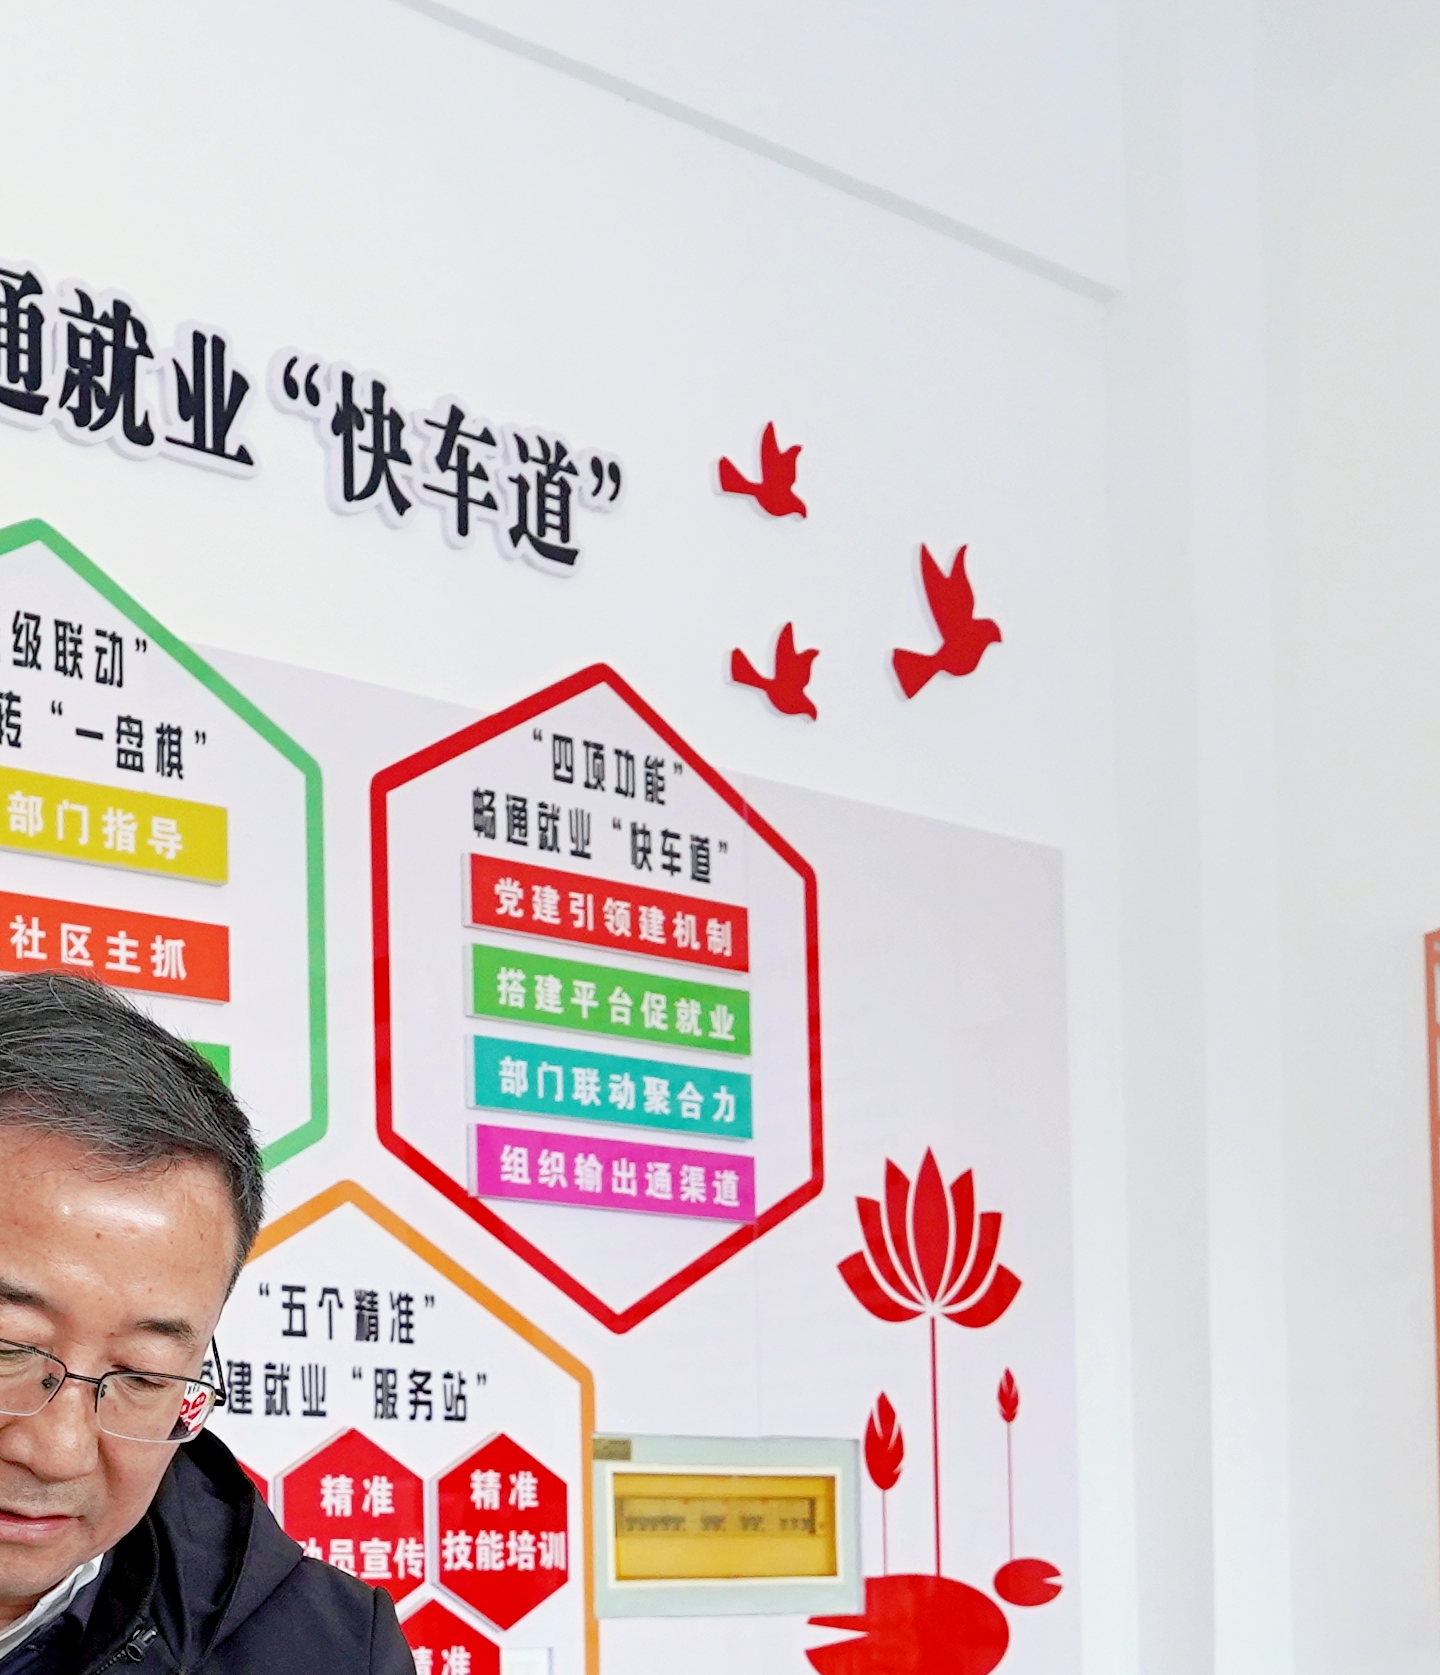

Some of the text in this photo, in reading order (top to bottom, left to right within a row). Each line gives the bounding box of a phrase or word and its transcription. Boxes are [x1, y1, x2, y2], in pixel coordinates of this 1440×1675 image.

[532, 728, 684, 806] “四项功能”
[472, 787, 729, 884] 畅通就业“快车道”
[494, 877, 733, 958] 党建引领建机制
[497, 966, 736, 1042] 搭建平台促就业
[499, 1055, 736, 1123] 部门联动聚合力
[500, 1145, 740, 1207] 组织输出通渠道
[259, 1282, 435, 1345] “五个精准”
[320, 1474, 396, 1518] 精准
[469, 1469, 541, 1512] 精准
[442, 1530, 567, 1572] 技能培训
